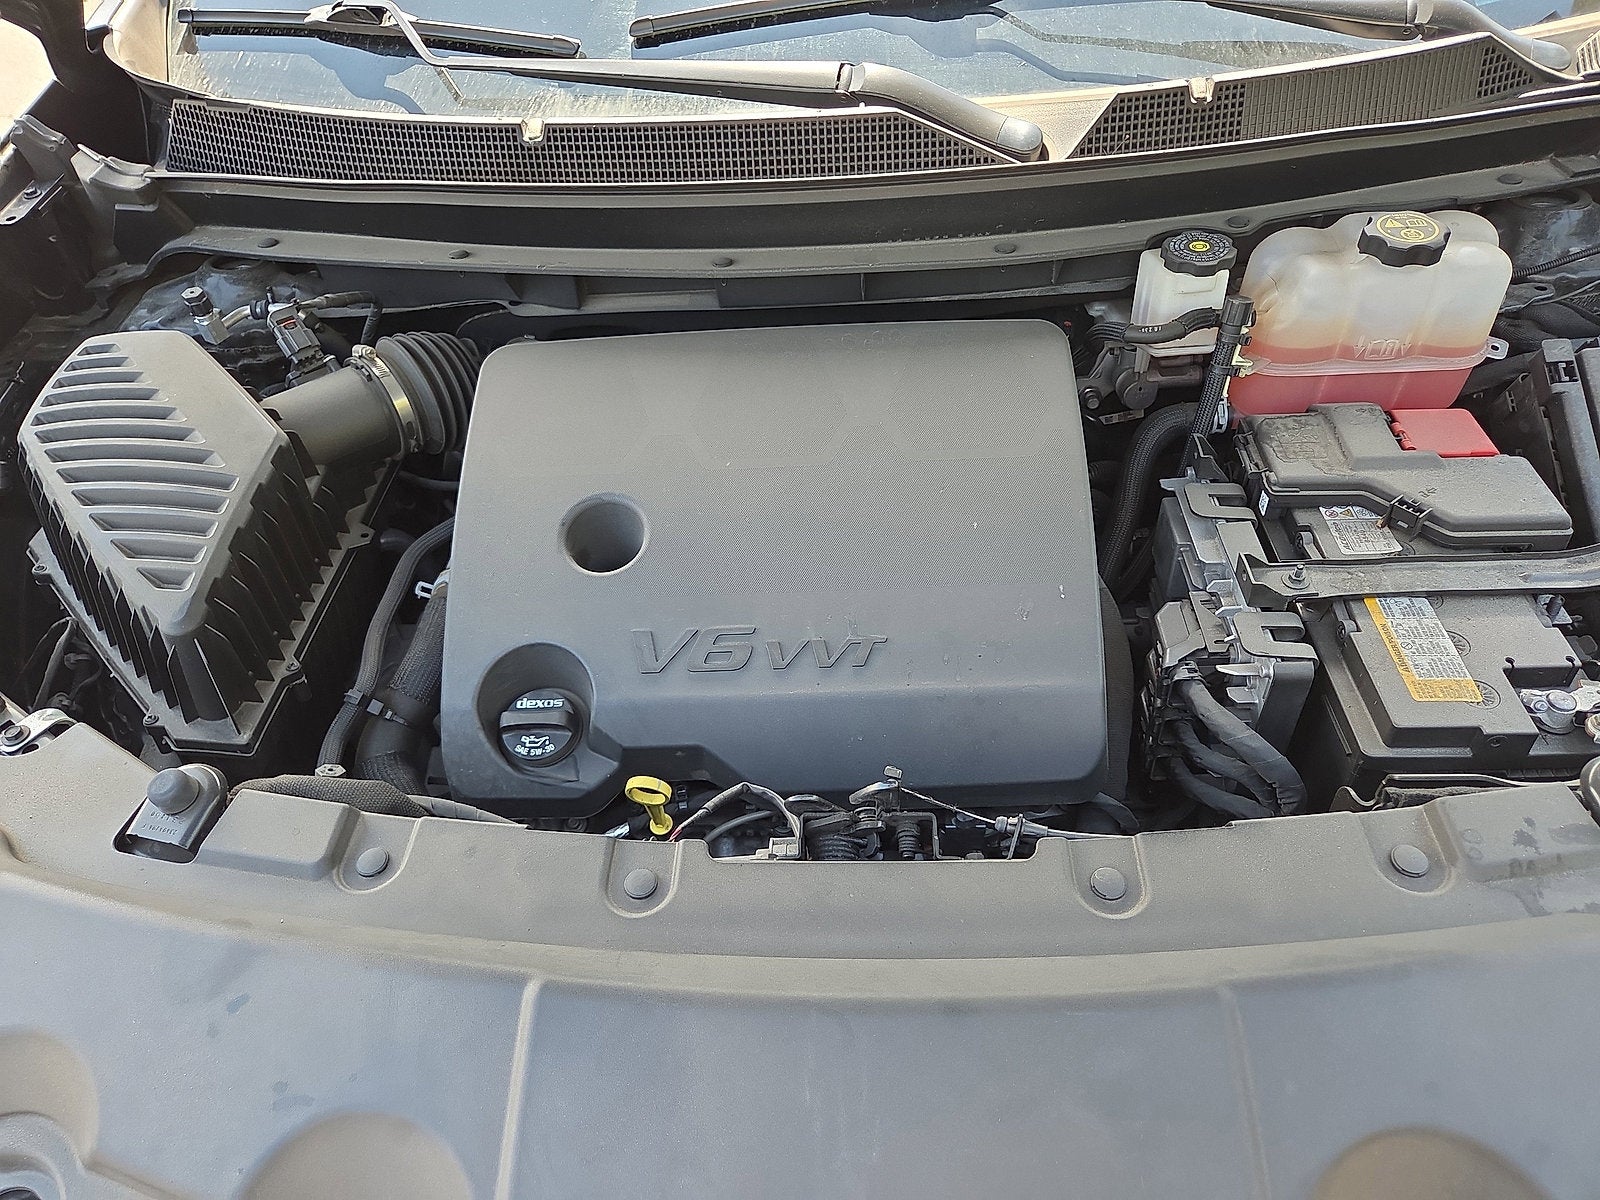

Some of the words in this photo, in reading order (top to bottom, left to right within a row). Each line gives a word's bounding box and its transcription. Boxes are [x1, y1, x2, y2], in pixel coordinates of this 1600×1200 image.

[631, 625, 757, 675] V6
[765, 634, 888, 671] VVT
[516, 698, 565, 709] dexos
[514, 744, 530, 756] SAE
